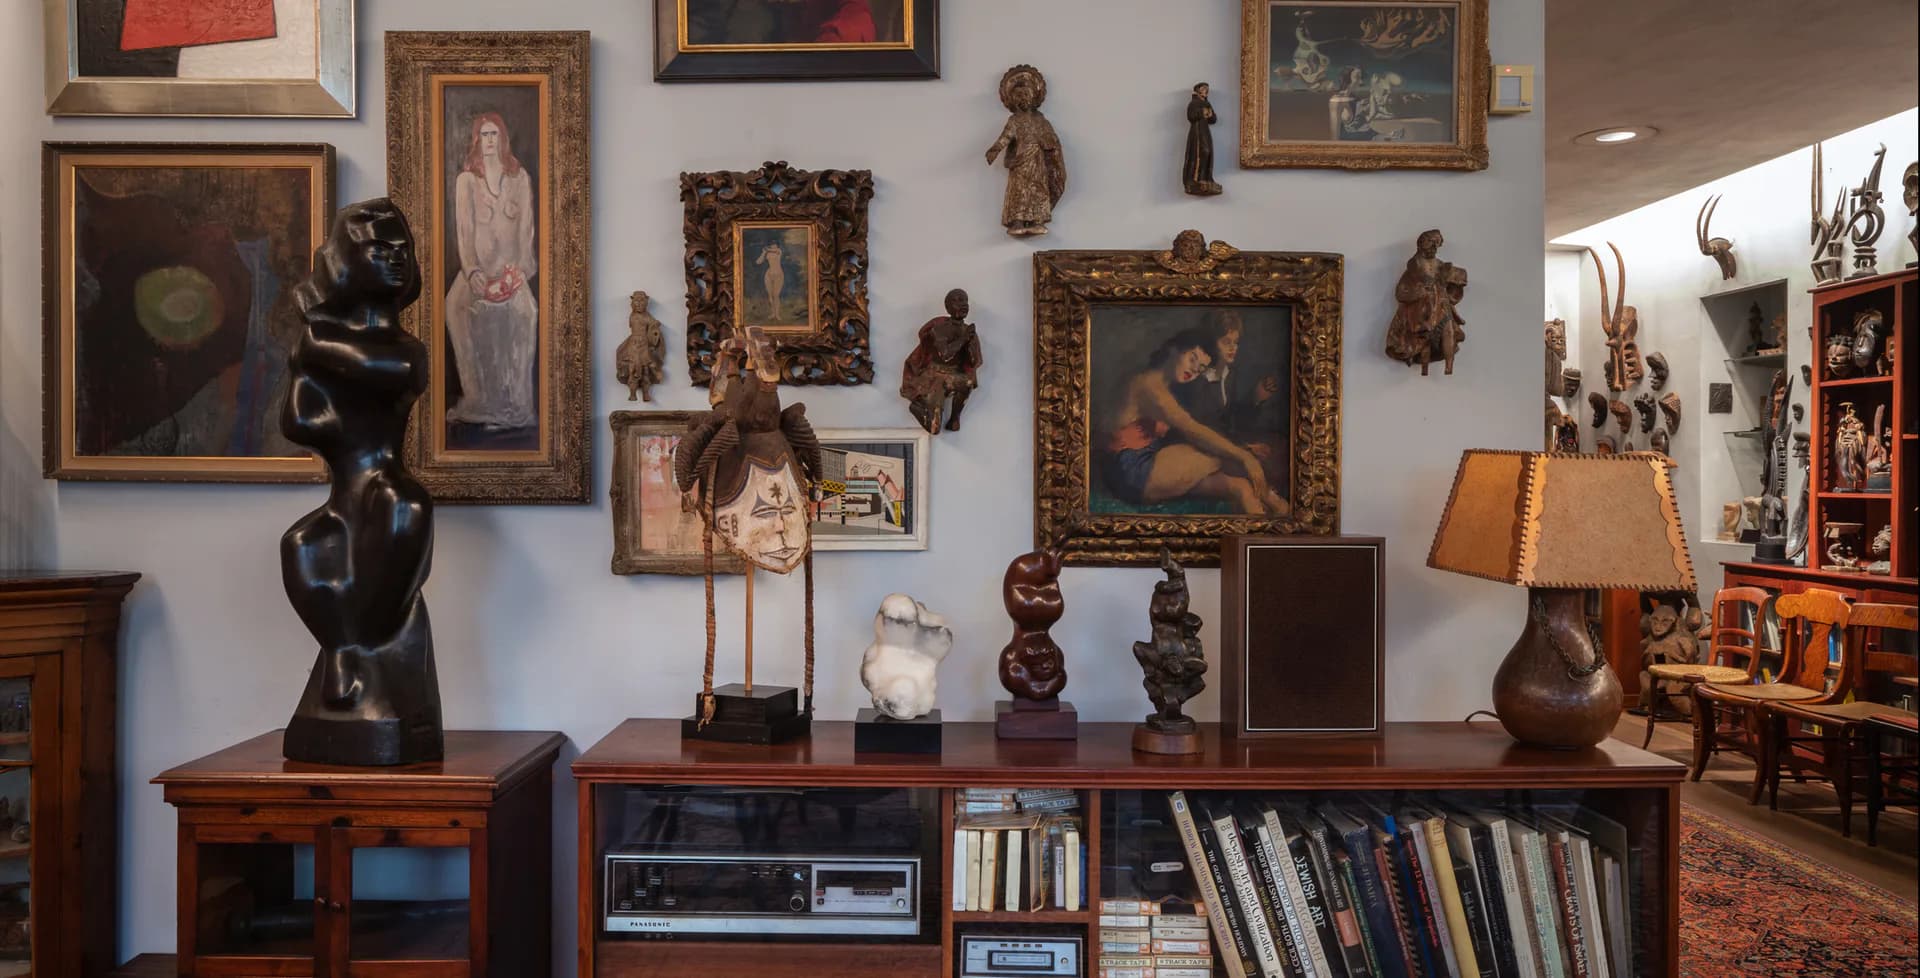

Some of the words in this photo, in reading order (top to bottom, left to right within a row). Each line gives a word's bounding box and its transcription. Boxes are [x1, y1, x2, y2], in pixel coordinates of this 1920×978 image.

[1207, 849, 1216, 862] THE
[1226, 831, 1245, 867] Jewish
[1255, 846, 1267, 868] JUDEN
[1182, 819, 1197, 848] HEBREW
[1193, 851, 1214, 899] ILLUMINATED
[1209, 900, 1231, 949] MANUSCRIPTS
[1212, 864, 1223, 883] GLORY
[1238, 868, 1251, 884] Art
[1262, 867, 1272, 883] DER
[1295, 856, 1317, 901] JEWISH
[1219, 884, 1226, 893] OF
[1222, 894, 1230, 905] THE
[1243, 885, 1258, 906] and
[1267, 883, 1280, 908] KUNST
[1268, 818, 1283, 841] BEN
[1277, 844, 1301, 892] SHAHN'S
[1293, 895, 1324, 961] HAGGADAH
[1278, 884, 1290, 908] KUNST
[1225, 907, 1238, 928] JEWISH
[1275, 908, 1284, 921] DIE
[1286, 909, 1294, 920] DIE
[1305, 905, 1326, 928] ART
[1563, 889, 1576, 926] CRAFTS
[1251, 906, 1274, 962] Civilization
[1280, 924, 1292, 946] ROTH
[1291, 923, 1303, 945] ROTH
[1570, 927, 1579, 941] OF
[1287, 945, 1299, 967] CECIL
[1299, 947, 1310, 967] CECIL
[1573, 943, 1585, 975] ISRAEL
